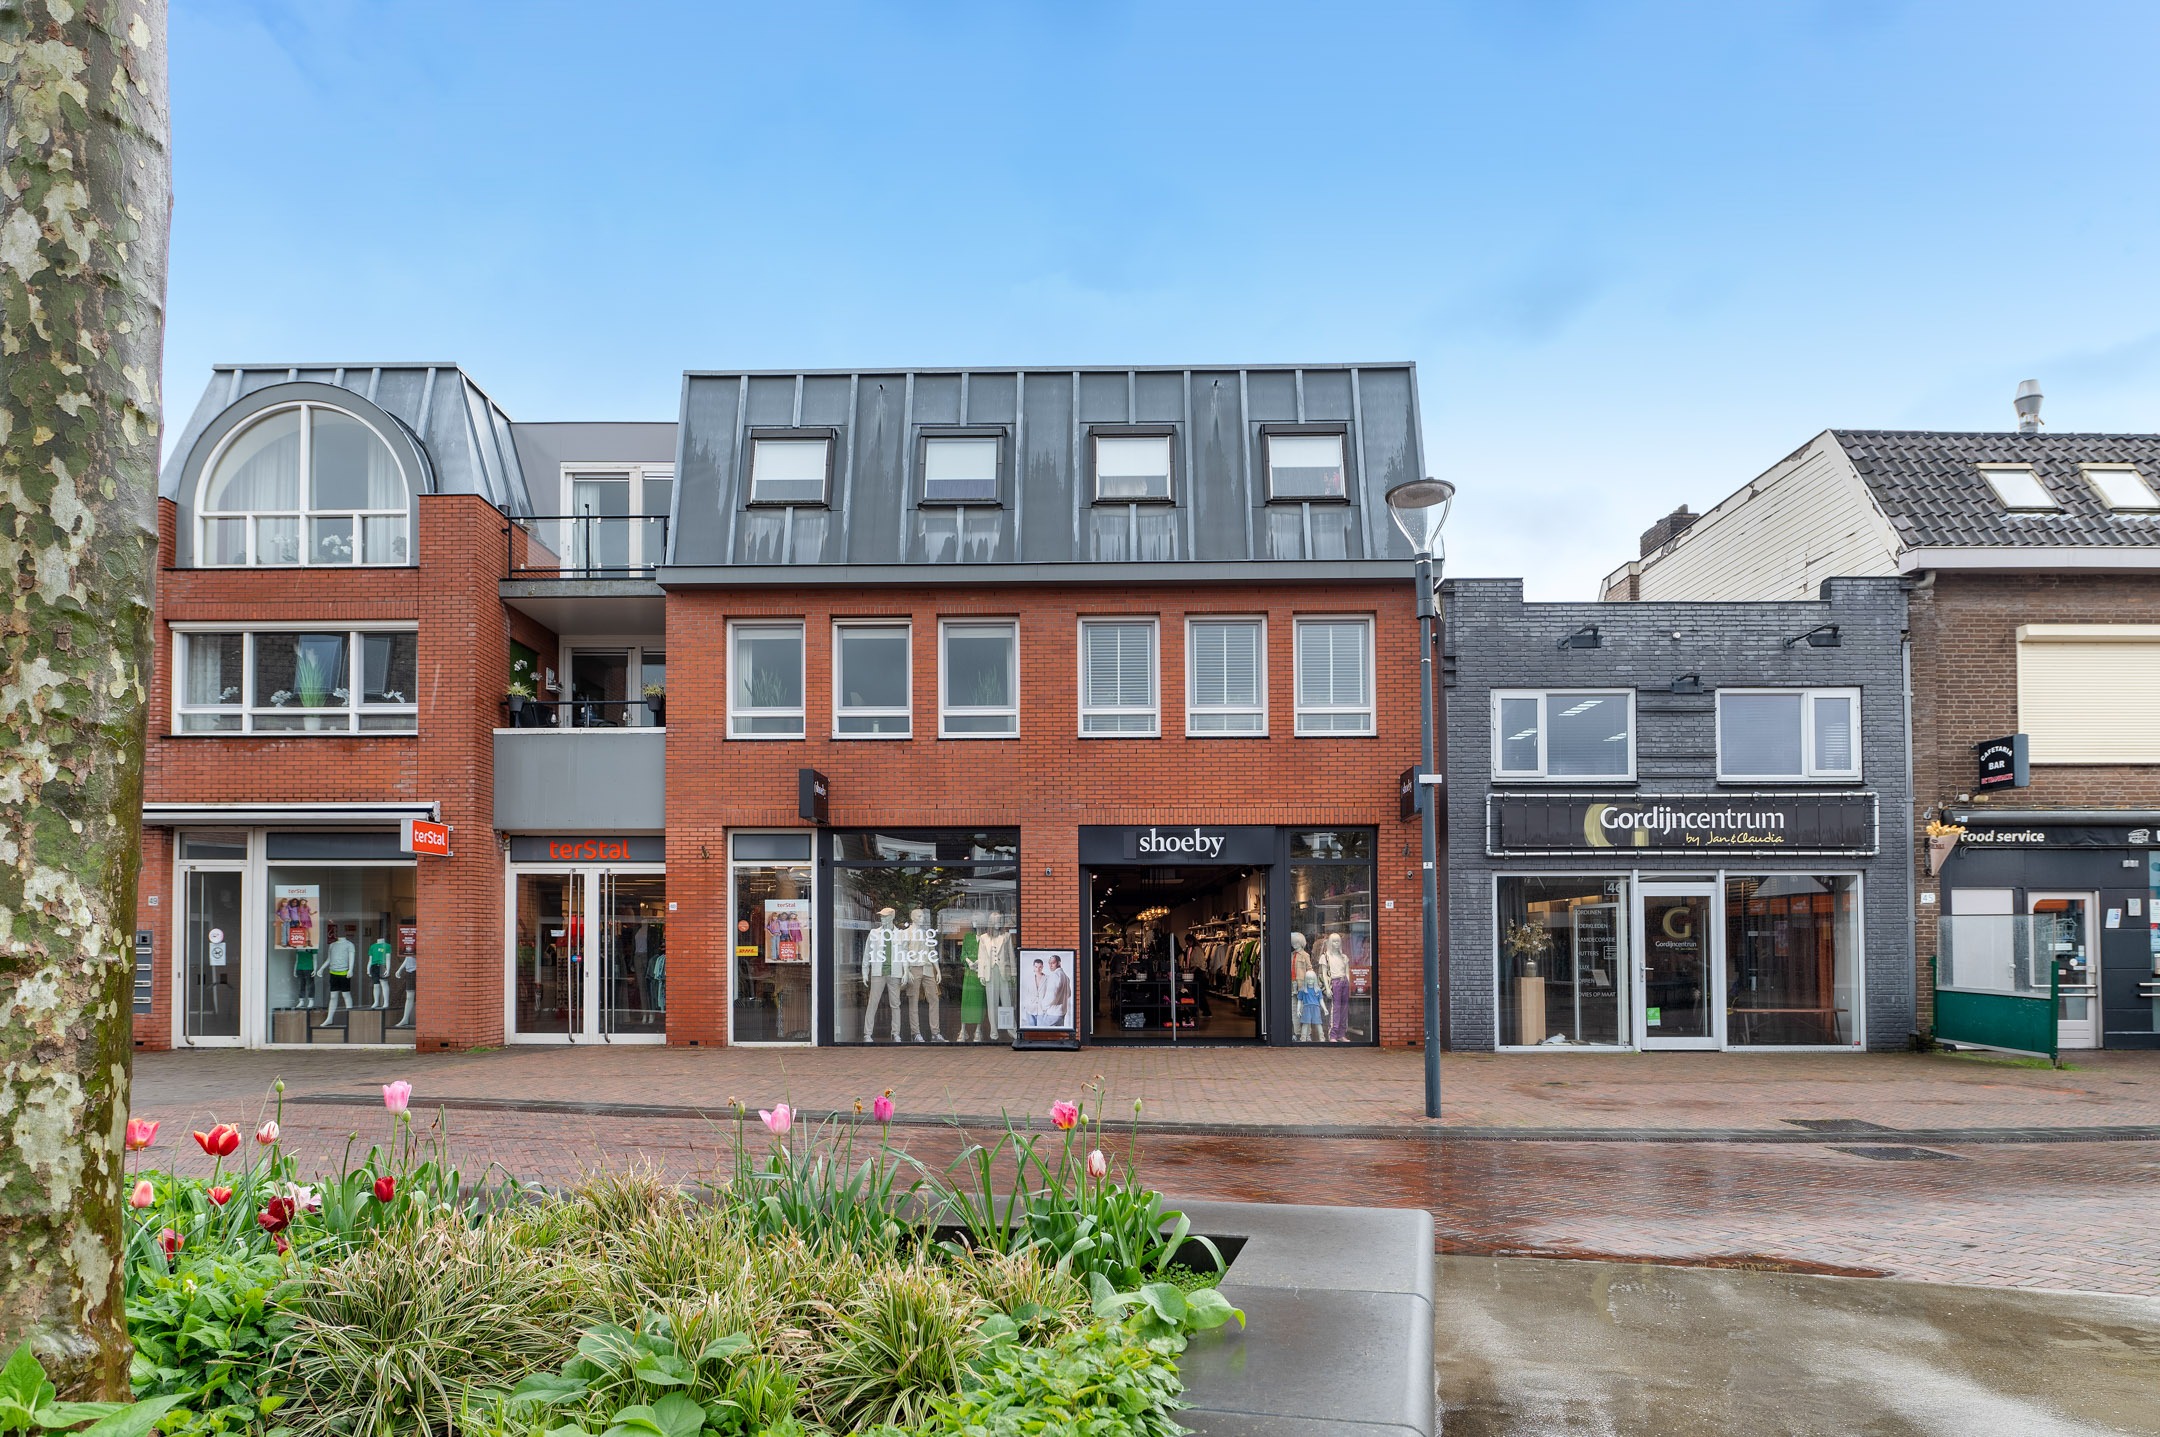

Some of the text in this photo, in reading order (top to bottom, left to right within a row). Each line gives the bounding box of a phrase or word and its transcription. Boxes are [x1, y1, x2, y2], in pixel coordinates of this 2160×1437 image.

[1980, 745, 2013, 762] CAFETARIA
[1988, 760, 2005, 770] BAR
[1600, 806, 1785, 835] Gordijncentrum
[414, 829, 446, 846] terStal
[1139, 827, 1225, 858] shoeby
[1685, 832, 1700, 846] by
[1960, 829, 2046, 842] Food service
[549, 839, 632, 860] terStal
[149, 897, 158, 905] 49
[1922, 894, 1935, 902] 45
[1662, 906, 1692, 940] G
[869, 921, 939, 947] spring
[868, 943, 940, 963] is here
